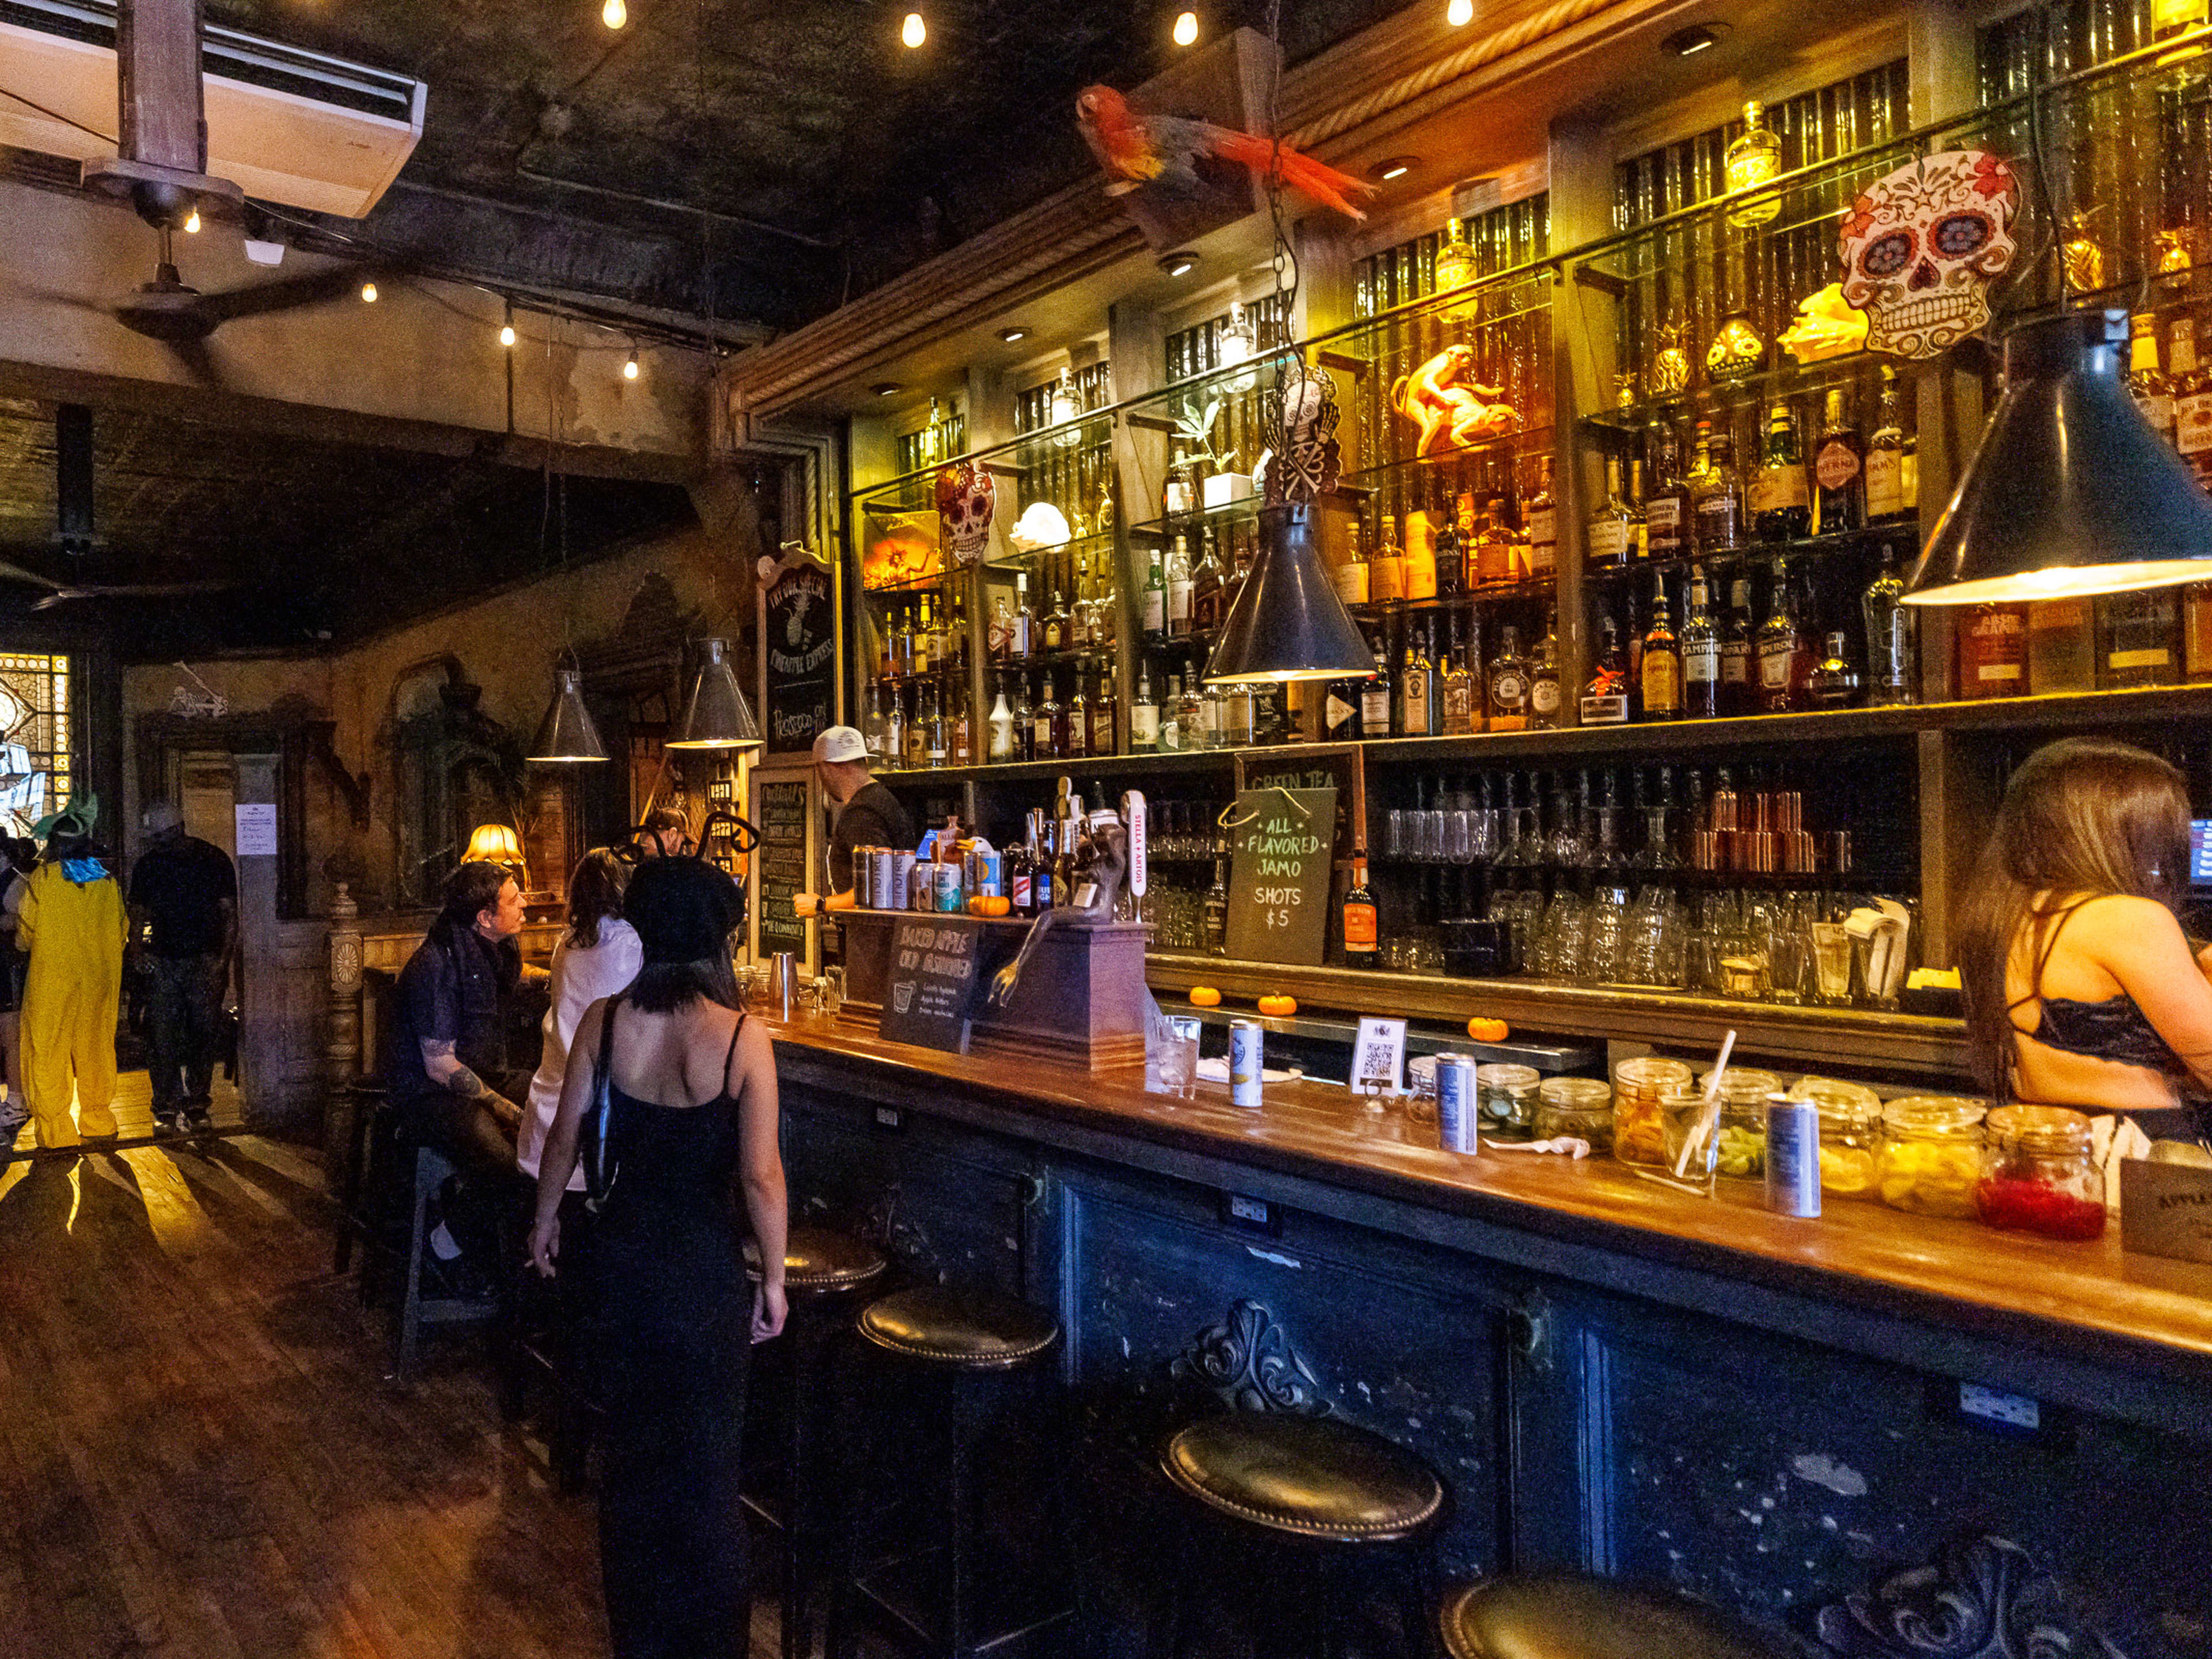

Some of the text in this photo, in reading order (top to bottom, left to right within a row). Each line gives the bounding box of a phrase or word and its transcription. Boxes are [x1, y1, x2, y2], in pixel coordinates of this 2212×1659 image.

[805, 638, 835, 672] EXPRESS
[1681, 643, 1722, 656] CAMPARI
[1252, 770, 1334, 790] GREEN TEA
[1266, 817, 1292, 834] ALL
[1247, 835, 1320, 855] FLAVORED
[1256, 859, 1302, 878] JAMO
[1254, 887, 1302, 906] SHOTS
[933, 929, 969, 954] APPLE
[899, 949, 973, 980] OLD FASHIONED
